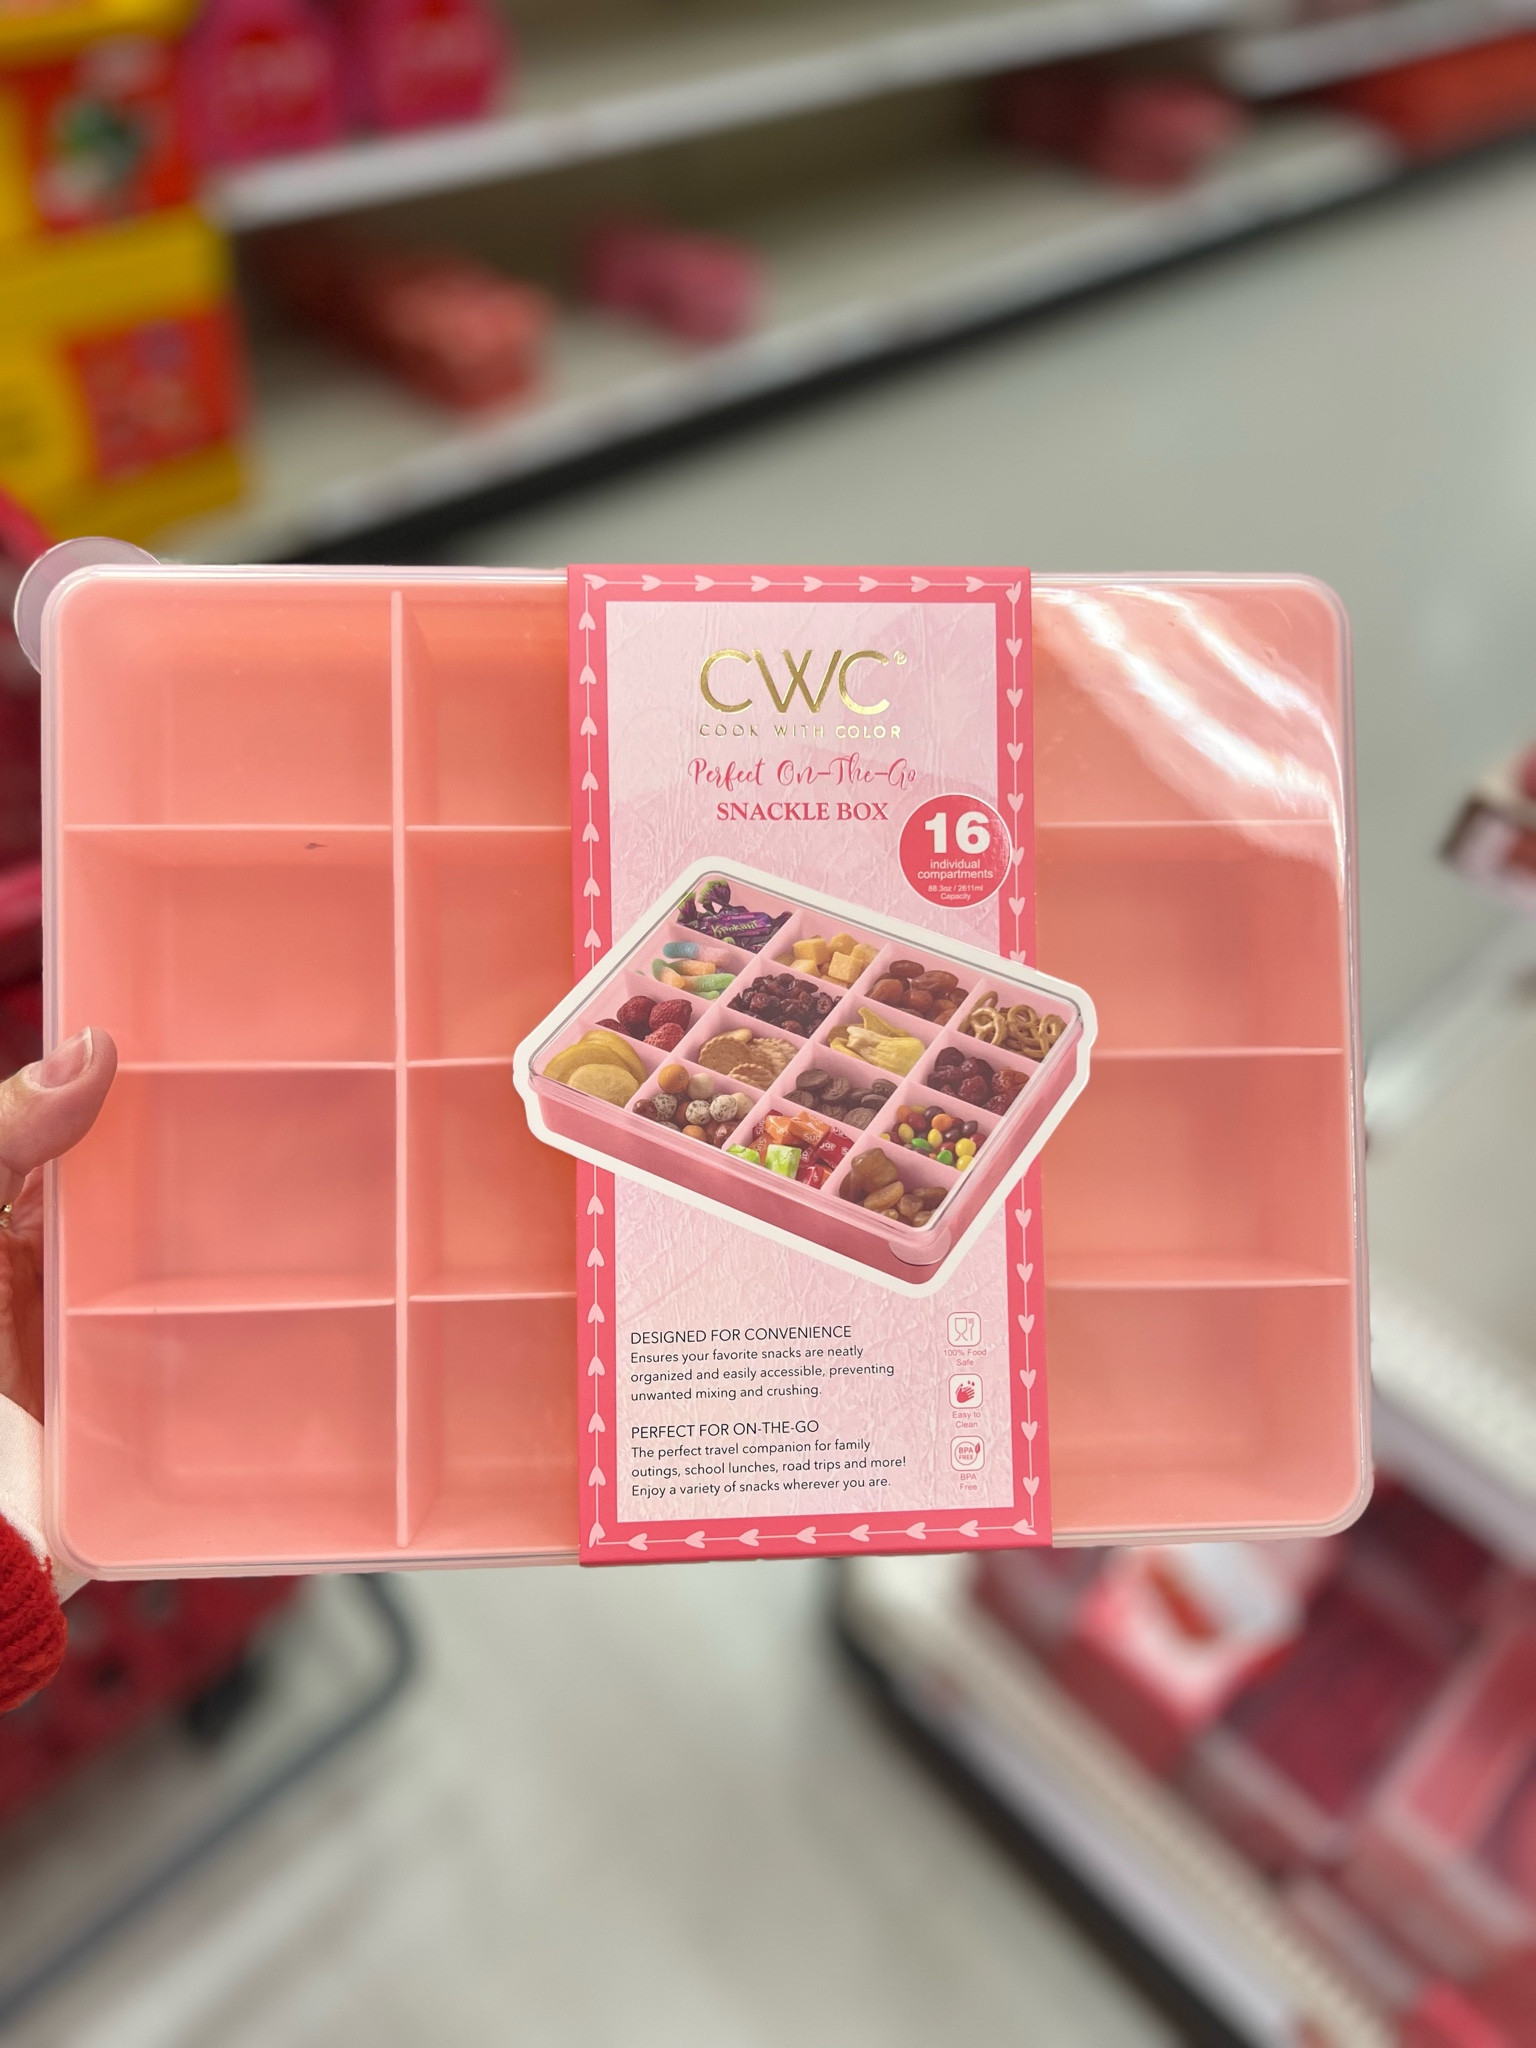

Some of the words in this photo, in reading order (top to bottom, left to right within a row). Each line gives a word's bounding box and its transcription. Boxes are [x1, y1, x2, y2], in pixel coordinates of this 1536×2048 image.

[699, 724, 758, 737] COOK
[774, 725, 825, 738] WITH
[835, 725, 901, 738] COLOR
[688, 757, 764, 792] Perfect
[777, 752, 916, 790] On-The-Go
[717, 803, 830, 821] SNACKLE
[837, 803, 888, 820] BOX
[925, 811, 990, 854] 16
[930, 859, 980, 869] individual
[918, 869, 993, 881] compartments
[630, 1330, 706, 1344] DESIGNED
[711, 1329, 740, 1342] FOR
[744, 1326, 852, 1341] CONVENIENCE
[630, 1352, 678, 1364] Ensures
[682, 1352, 708, 1364] your
[712, 1348, 758, 1361] favorite
[762, 1348, 801, 1359] snacks
[804, 1348, 824, 1358] are
[827, 1346, 864, 1358] neatly
[630, 1370, 692, 1385] organized
[696, 1368, 720, 1380] and
[722, 1368, 756, 1380] easily
[760, 1365, 826, 1378] accessible,
[829, 1364, 894, 1378] preventing
[630, 1388, 692, 1402] unwanted
[696, 1387, 736, 1400] mixing
[740, 1386, 763, 1398] and
[766, 1384, 822, 1398] crushing.
[631, 1424, 696, 1439] PERFECT
[699, 1424, 729, 1436] FOR
[733, 1420, 819, 1436] ON-THE-GO
[632, 1447, 654, 1458] The
[658, 1445, 702, 1460] perfect
[705, 1444, 739, 1456] travel
[742, 1441, 811, 1455] companion
[814, 1440, 831, 1450] for
[834, 1438, 870, 1452] family
[632, 1466, 681, 1480] outings,
[684, 1464, 724, 1475] school
[728, 1462, 778, 1474] lunches,
[782, 1460, 810, 1471] road
[814, 1458, 840, 1472] trips
[844, 1458, 867, 1468] and
[870, 1456, 906, 1468] more!
[632, 1484, 666, 1499] Enjoy
[680, 1483, 720, 1496] variety
[724, 1480, 736, 1492] of
[739, 1480, 780, 1492] snacks
[783, 1478, 840, 1490] wherever
[842, 1479, 865, 1491] you
[868, 1476, 891, 1487] are.
